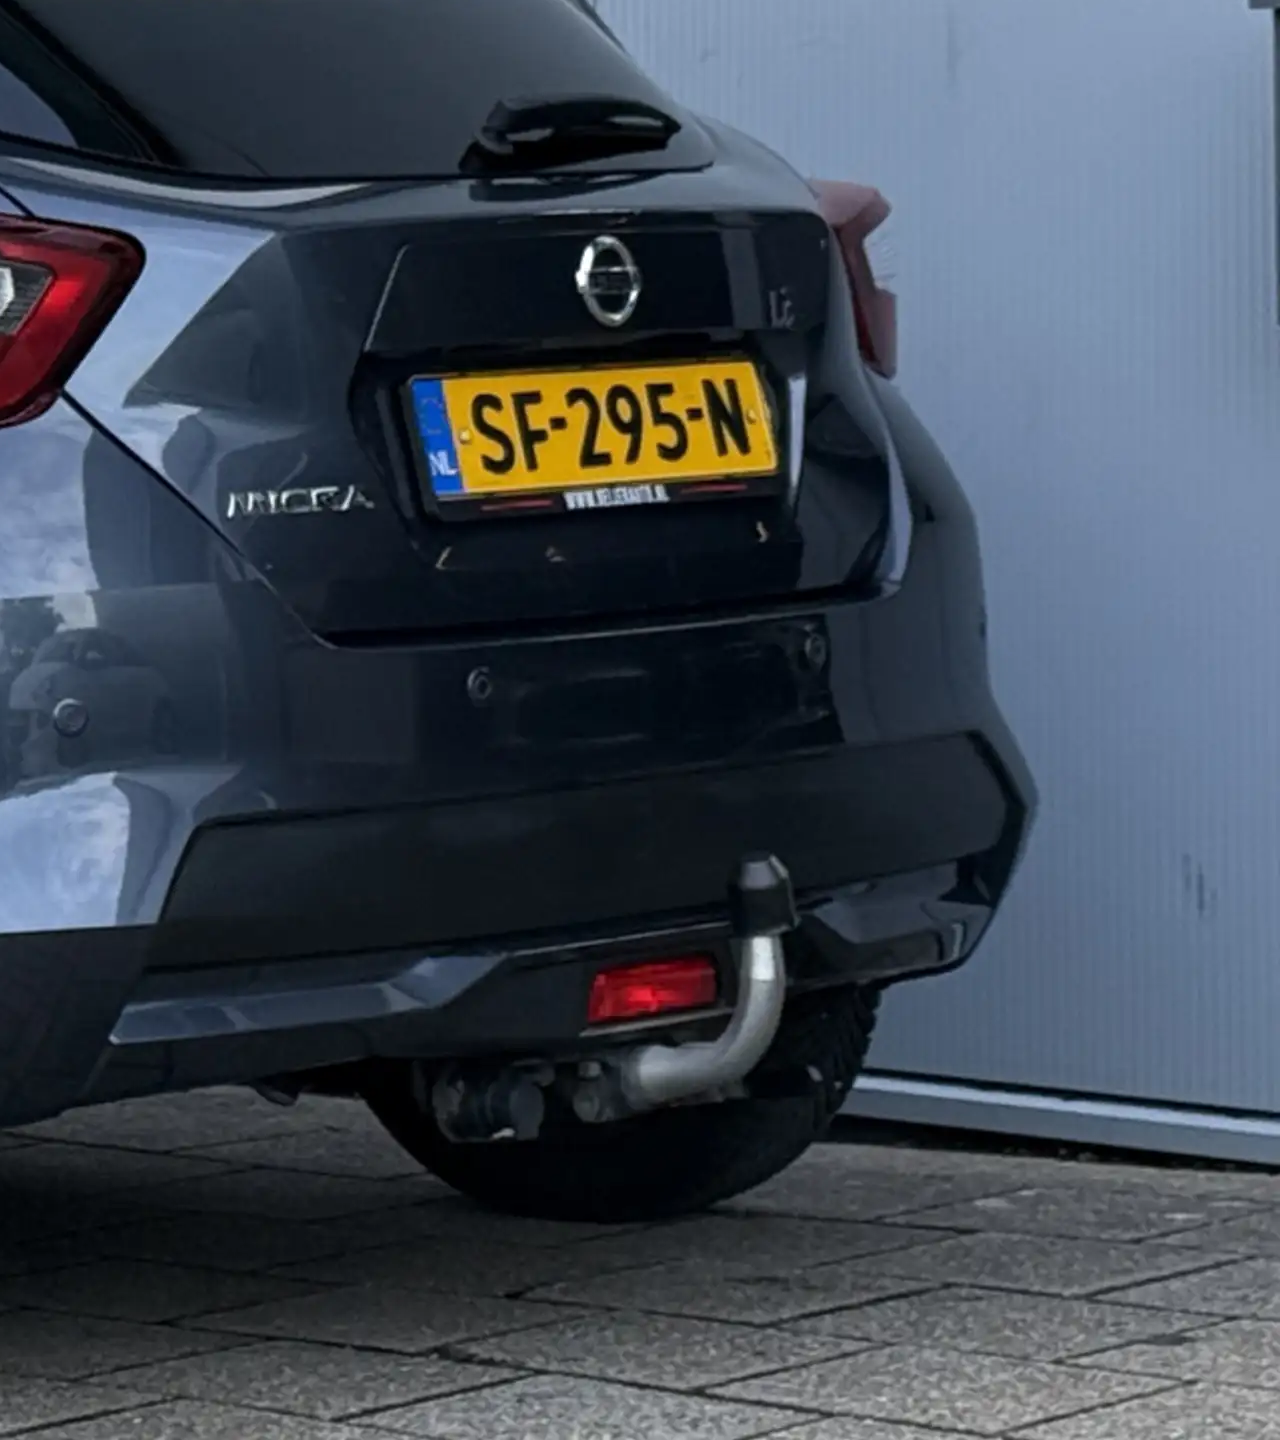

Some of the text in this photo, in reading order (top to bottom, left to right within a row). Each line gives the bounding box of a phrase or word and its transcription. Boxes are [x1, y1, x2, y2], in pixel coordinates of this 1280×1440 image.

[470, 378, 751, 475] SF-295-N
[428, 450, 458, 477] NL
[226, 484, 376, 518] MICRA
